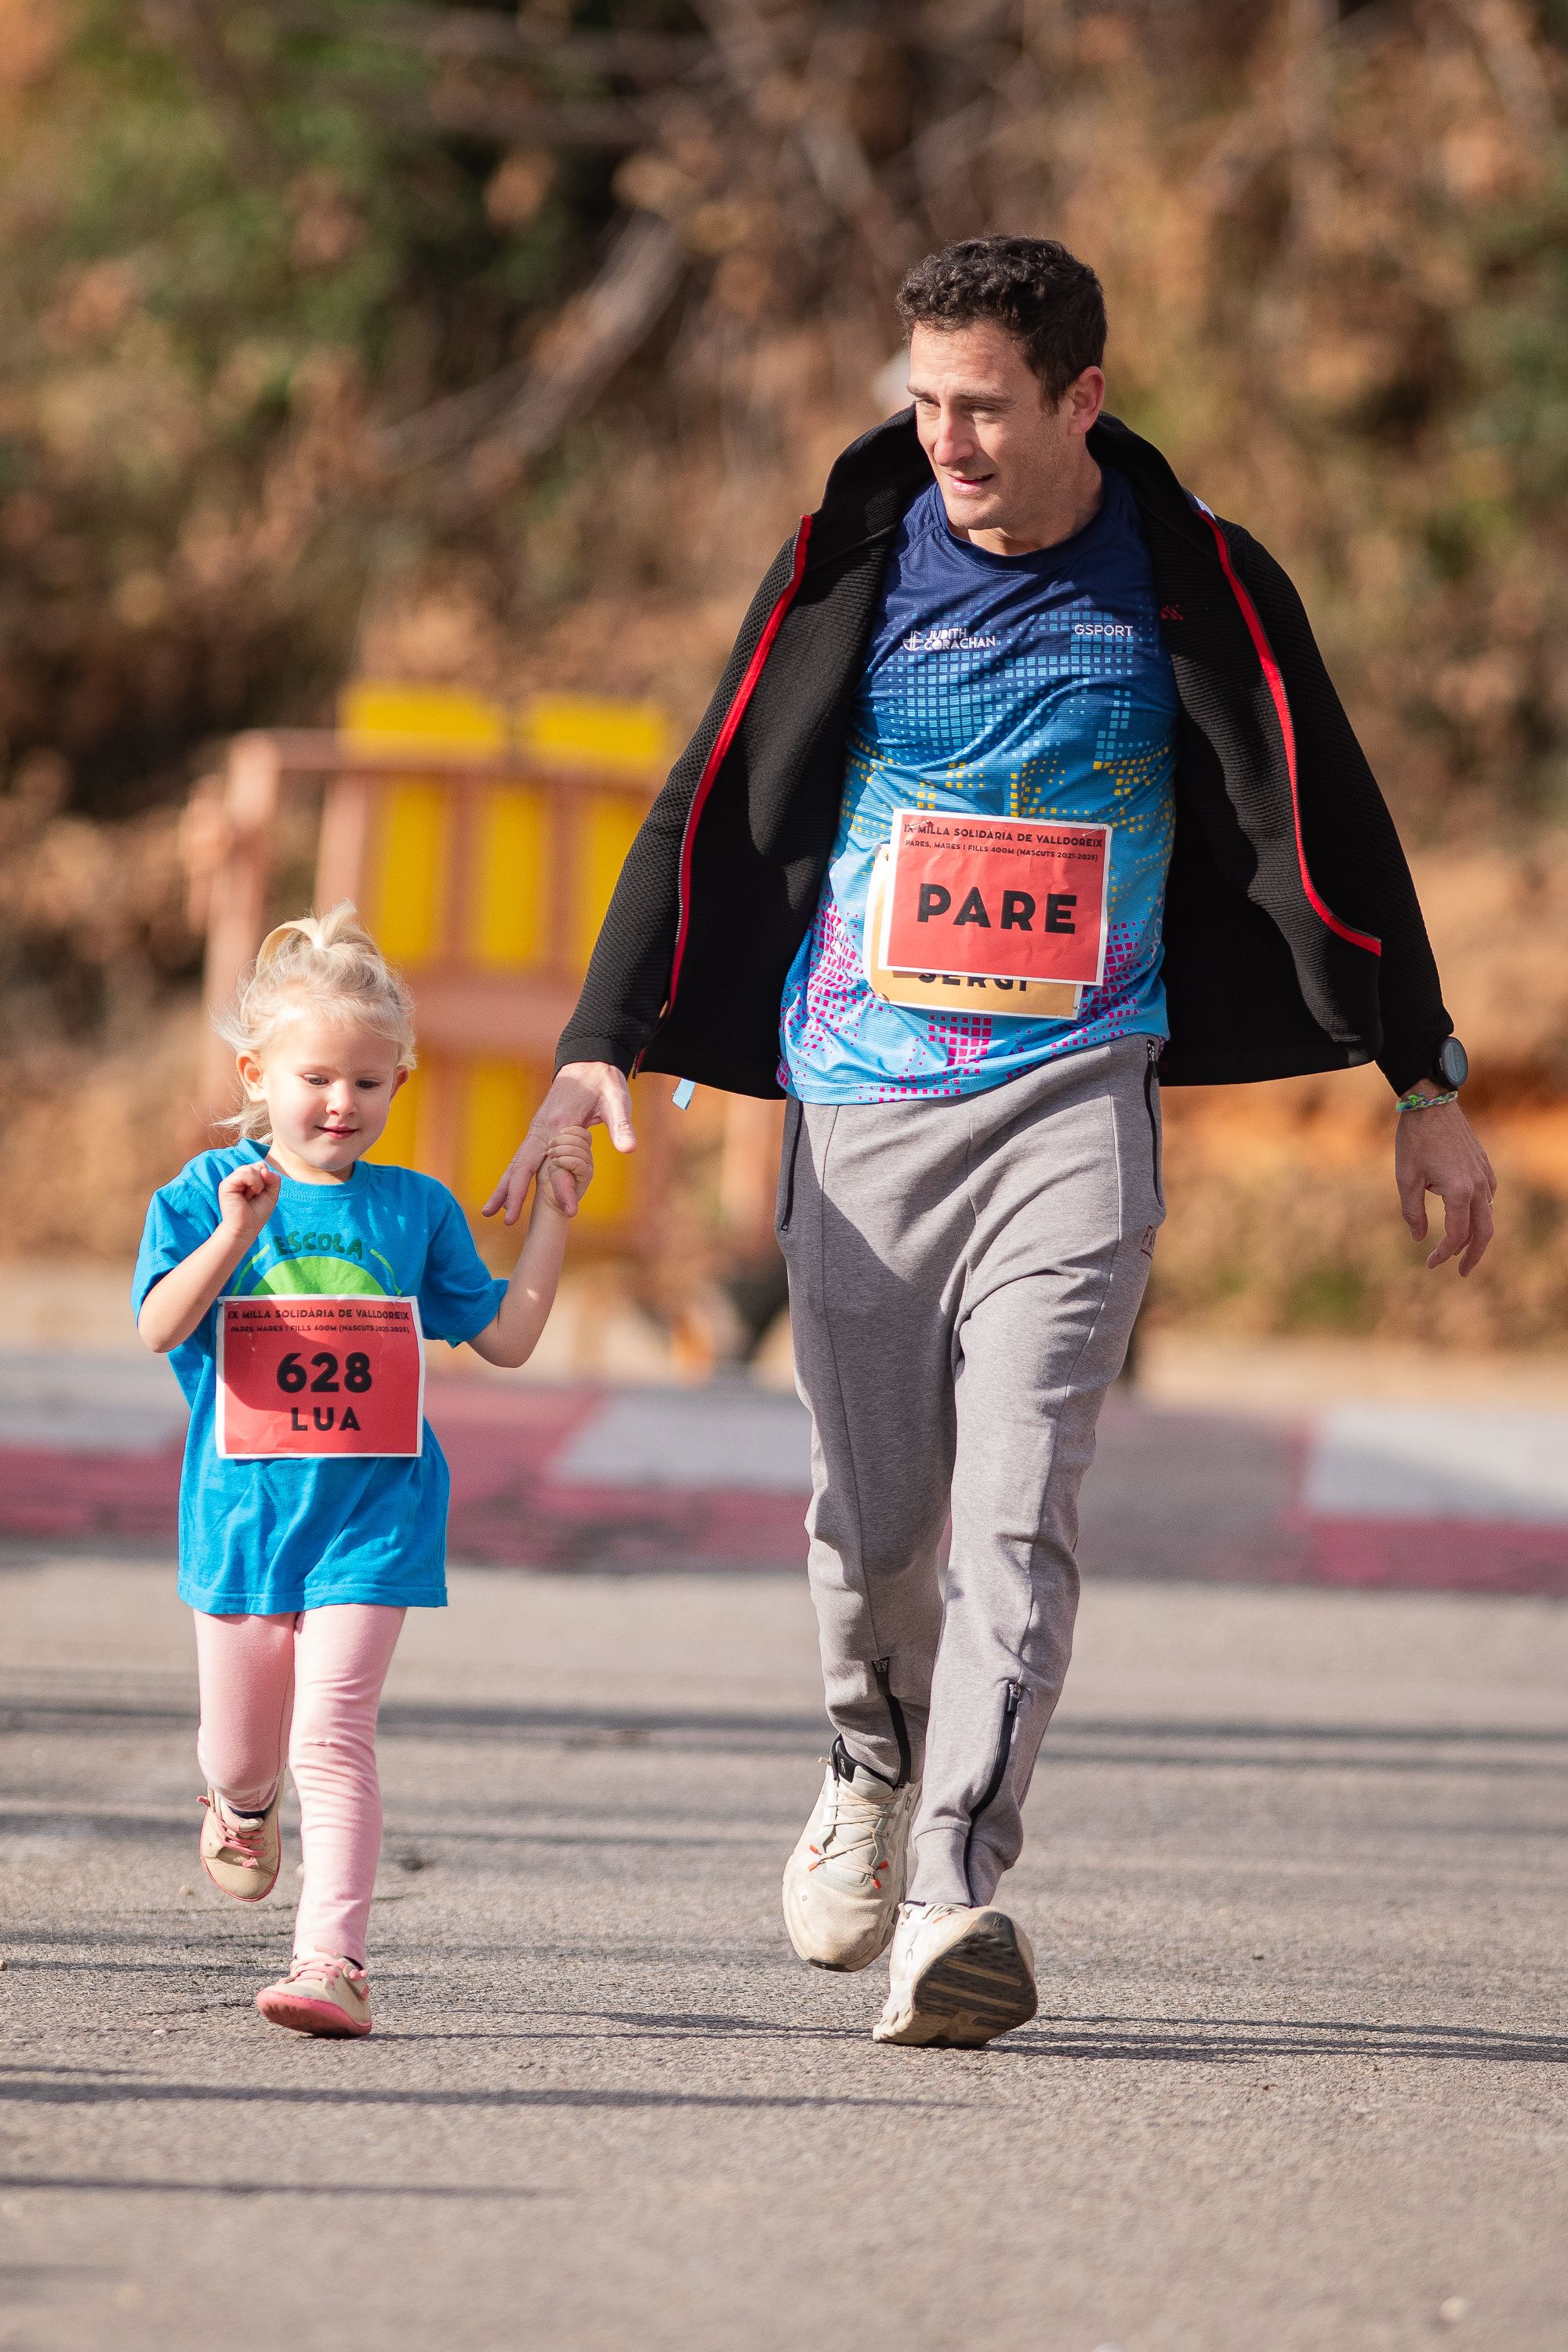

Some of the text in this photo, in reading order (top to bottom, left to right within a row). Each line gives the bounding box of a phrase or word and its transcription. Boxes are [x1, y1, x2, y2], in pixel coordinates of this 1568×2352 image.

[926, 628, 967, 641] JUDITH
[1074, 624, 1134, 637] GSPORT
[924, 635, 996, 651] CORACHAN
[917, 825, 950, 836] MILLA
[953, 828, 1013, 840] SOLIDÀRIA
[1016, 833, 1033, 843] DE
[1036, 834, 1103, 848] VALLDOREIX
[990, 846, 1014, 855] 400M
[1016, 848, 1055, 858] (NASCUTS
[916, 883, 1078, 935] PARE
[273, 1231, 363, 1261] ESCOLA
[227, 1307, 410, 1320] IX MILLA SOLIDÀRIA DE VALLDOREIX
[339, 1324, 374, 1333] (NASCUTS
[276, 1352, 372, 1393] 628
[291, 1406, 361, 1432] LUA
